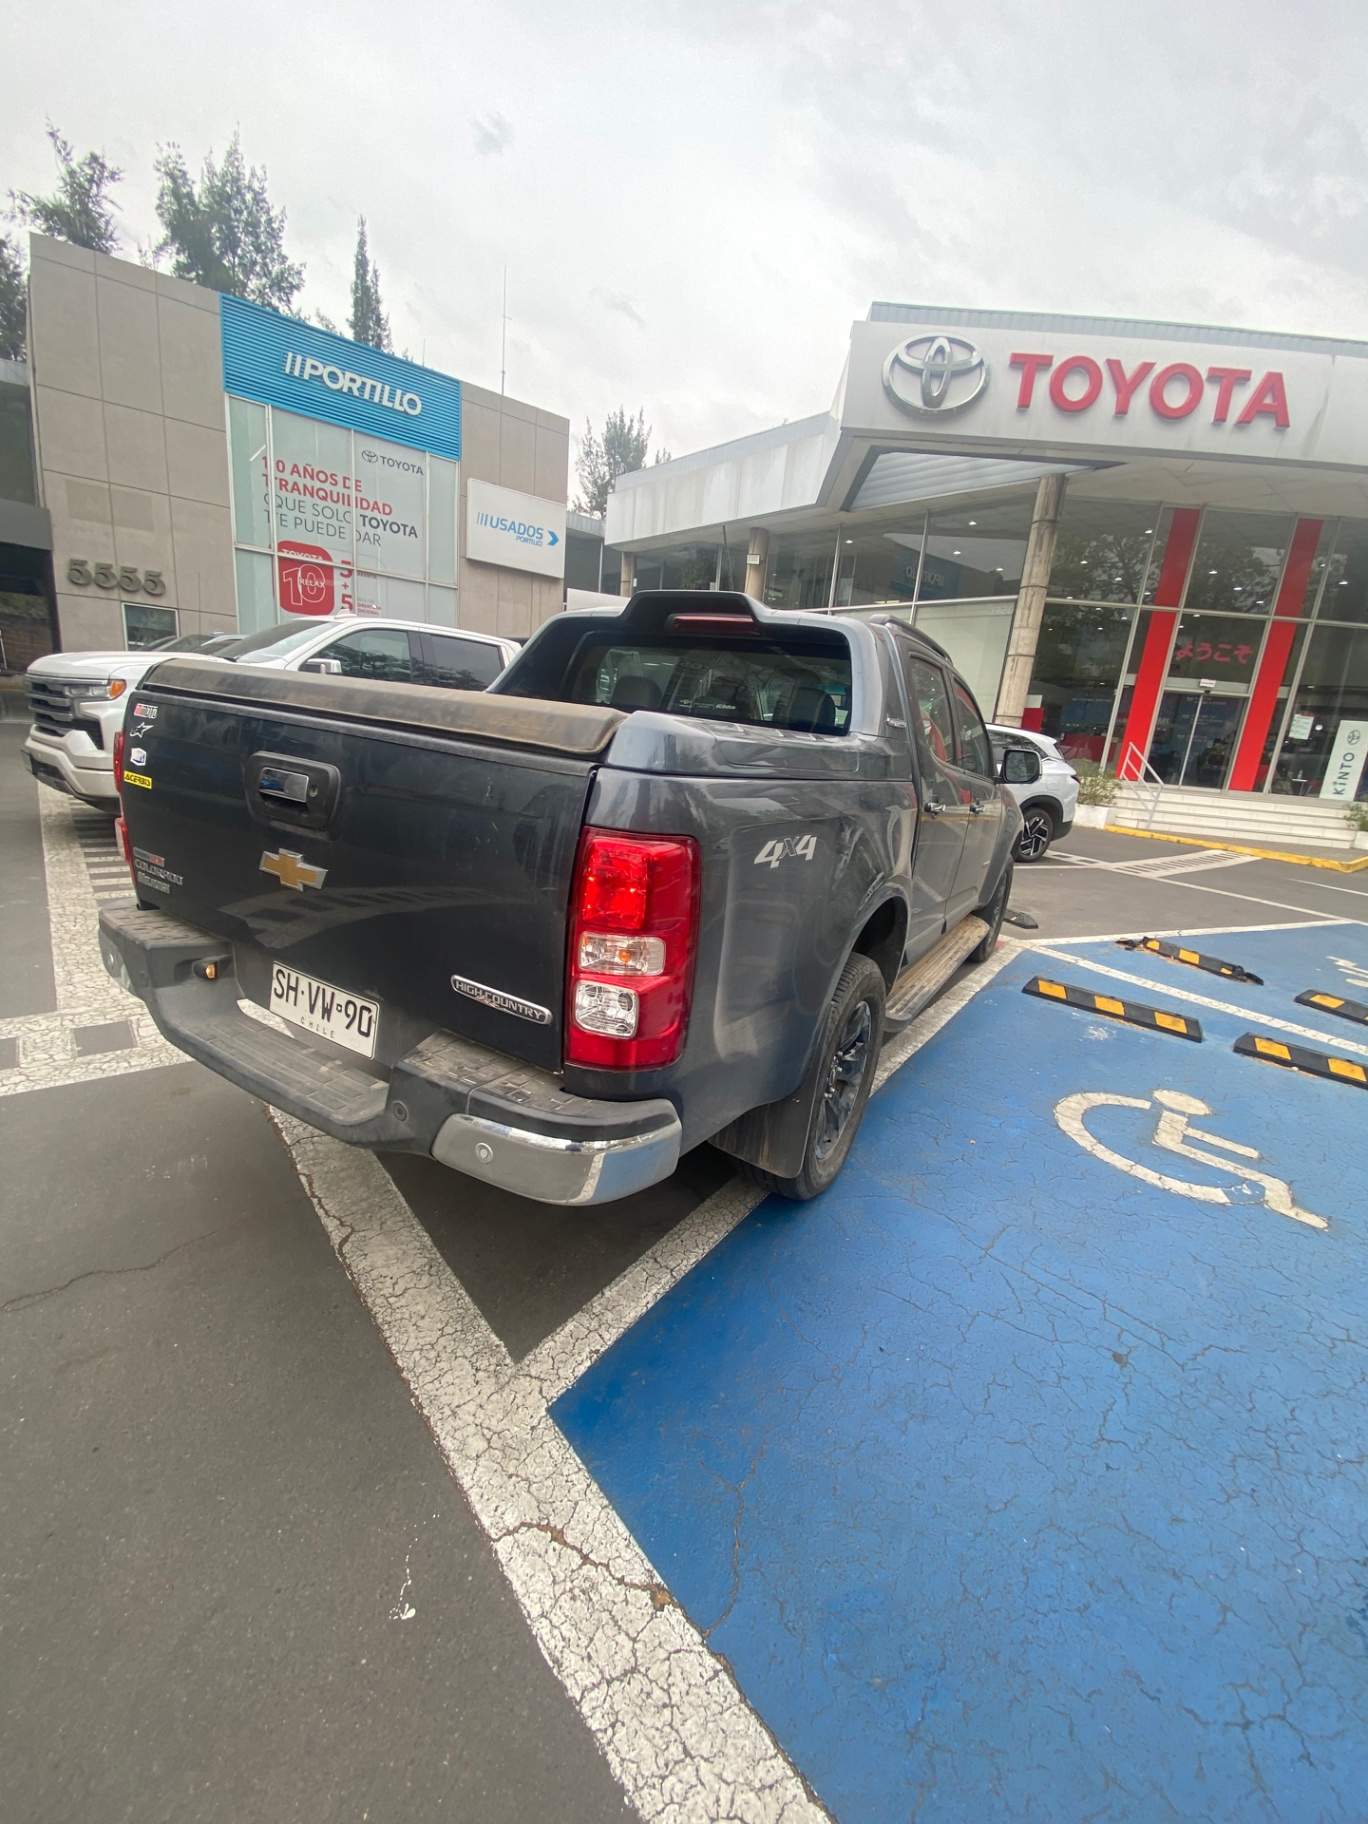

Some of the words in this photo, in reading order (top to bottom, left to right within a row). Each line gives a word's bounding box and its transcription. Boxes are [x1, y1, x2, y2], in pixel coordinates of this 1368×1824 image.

[303, 358, 422, 416] PORTILLO
[1009, 353, 1290, 429] TOYOTA
[262, 456, 285, 473] 10
[290, 463, 338, 487] AÑOS
[342, 476, 363, 493] DE
[380, 455, 424, 476] TOYOTA
[262, 473, 393, 516] TRANQUILIDAD
[264, 493, 306, 514] QUE
[360, 513, 418, 539] TOYOTA
[264, 509, 289, 528] TE
[294, 516, 346, 540] PUEDE
[490, 515, 544, 541] USADOS
[67, 558, 166, 597] 5555
[1177, 641, 1253, 665] ようこそ
[455, 980, 483, 998] HIGH
[485, 991, 543, 1021] COUNTRY
[301, 1016, 335, 1039] CHILE
